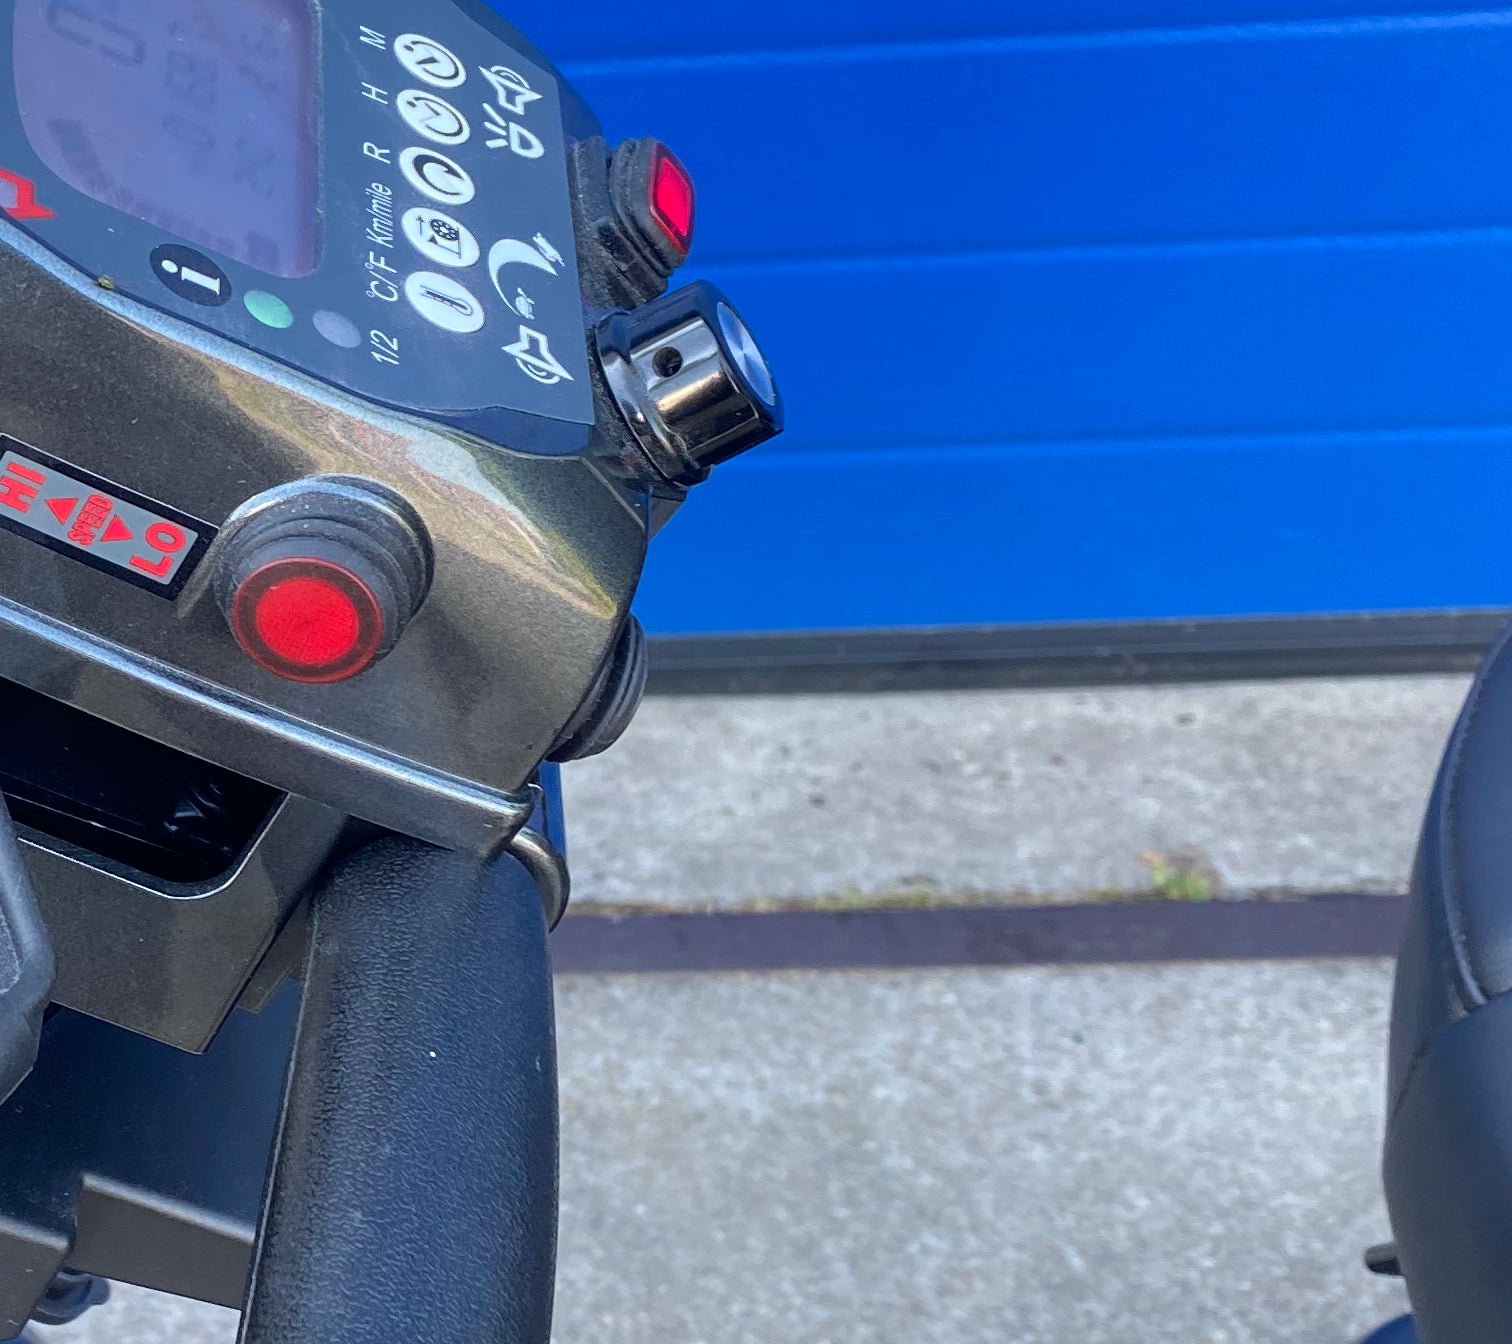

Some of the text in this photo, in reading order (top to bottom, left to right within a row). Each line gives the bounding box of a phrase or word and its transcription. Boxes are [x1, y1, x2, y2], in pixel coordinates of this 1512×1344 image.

[359, 24, 387, 51] M
[361, 80, 389, 106] H
[362, 141, 392, 165] R
[364, 181, 394, 250] Km/mile
[369, 328, 400, 367] 1/2
[66, 491, 114, 548] SPEED
[128, 521, 187, 578] LO
